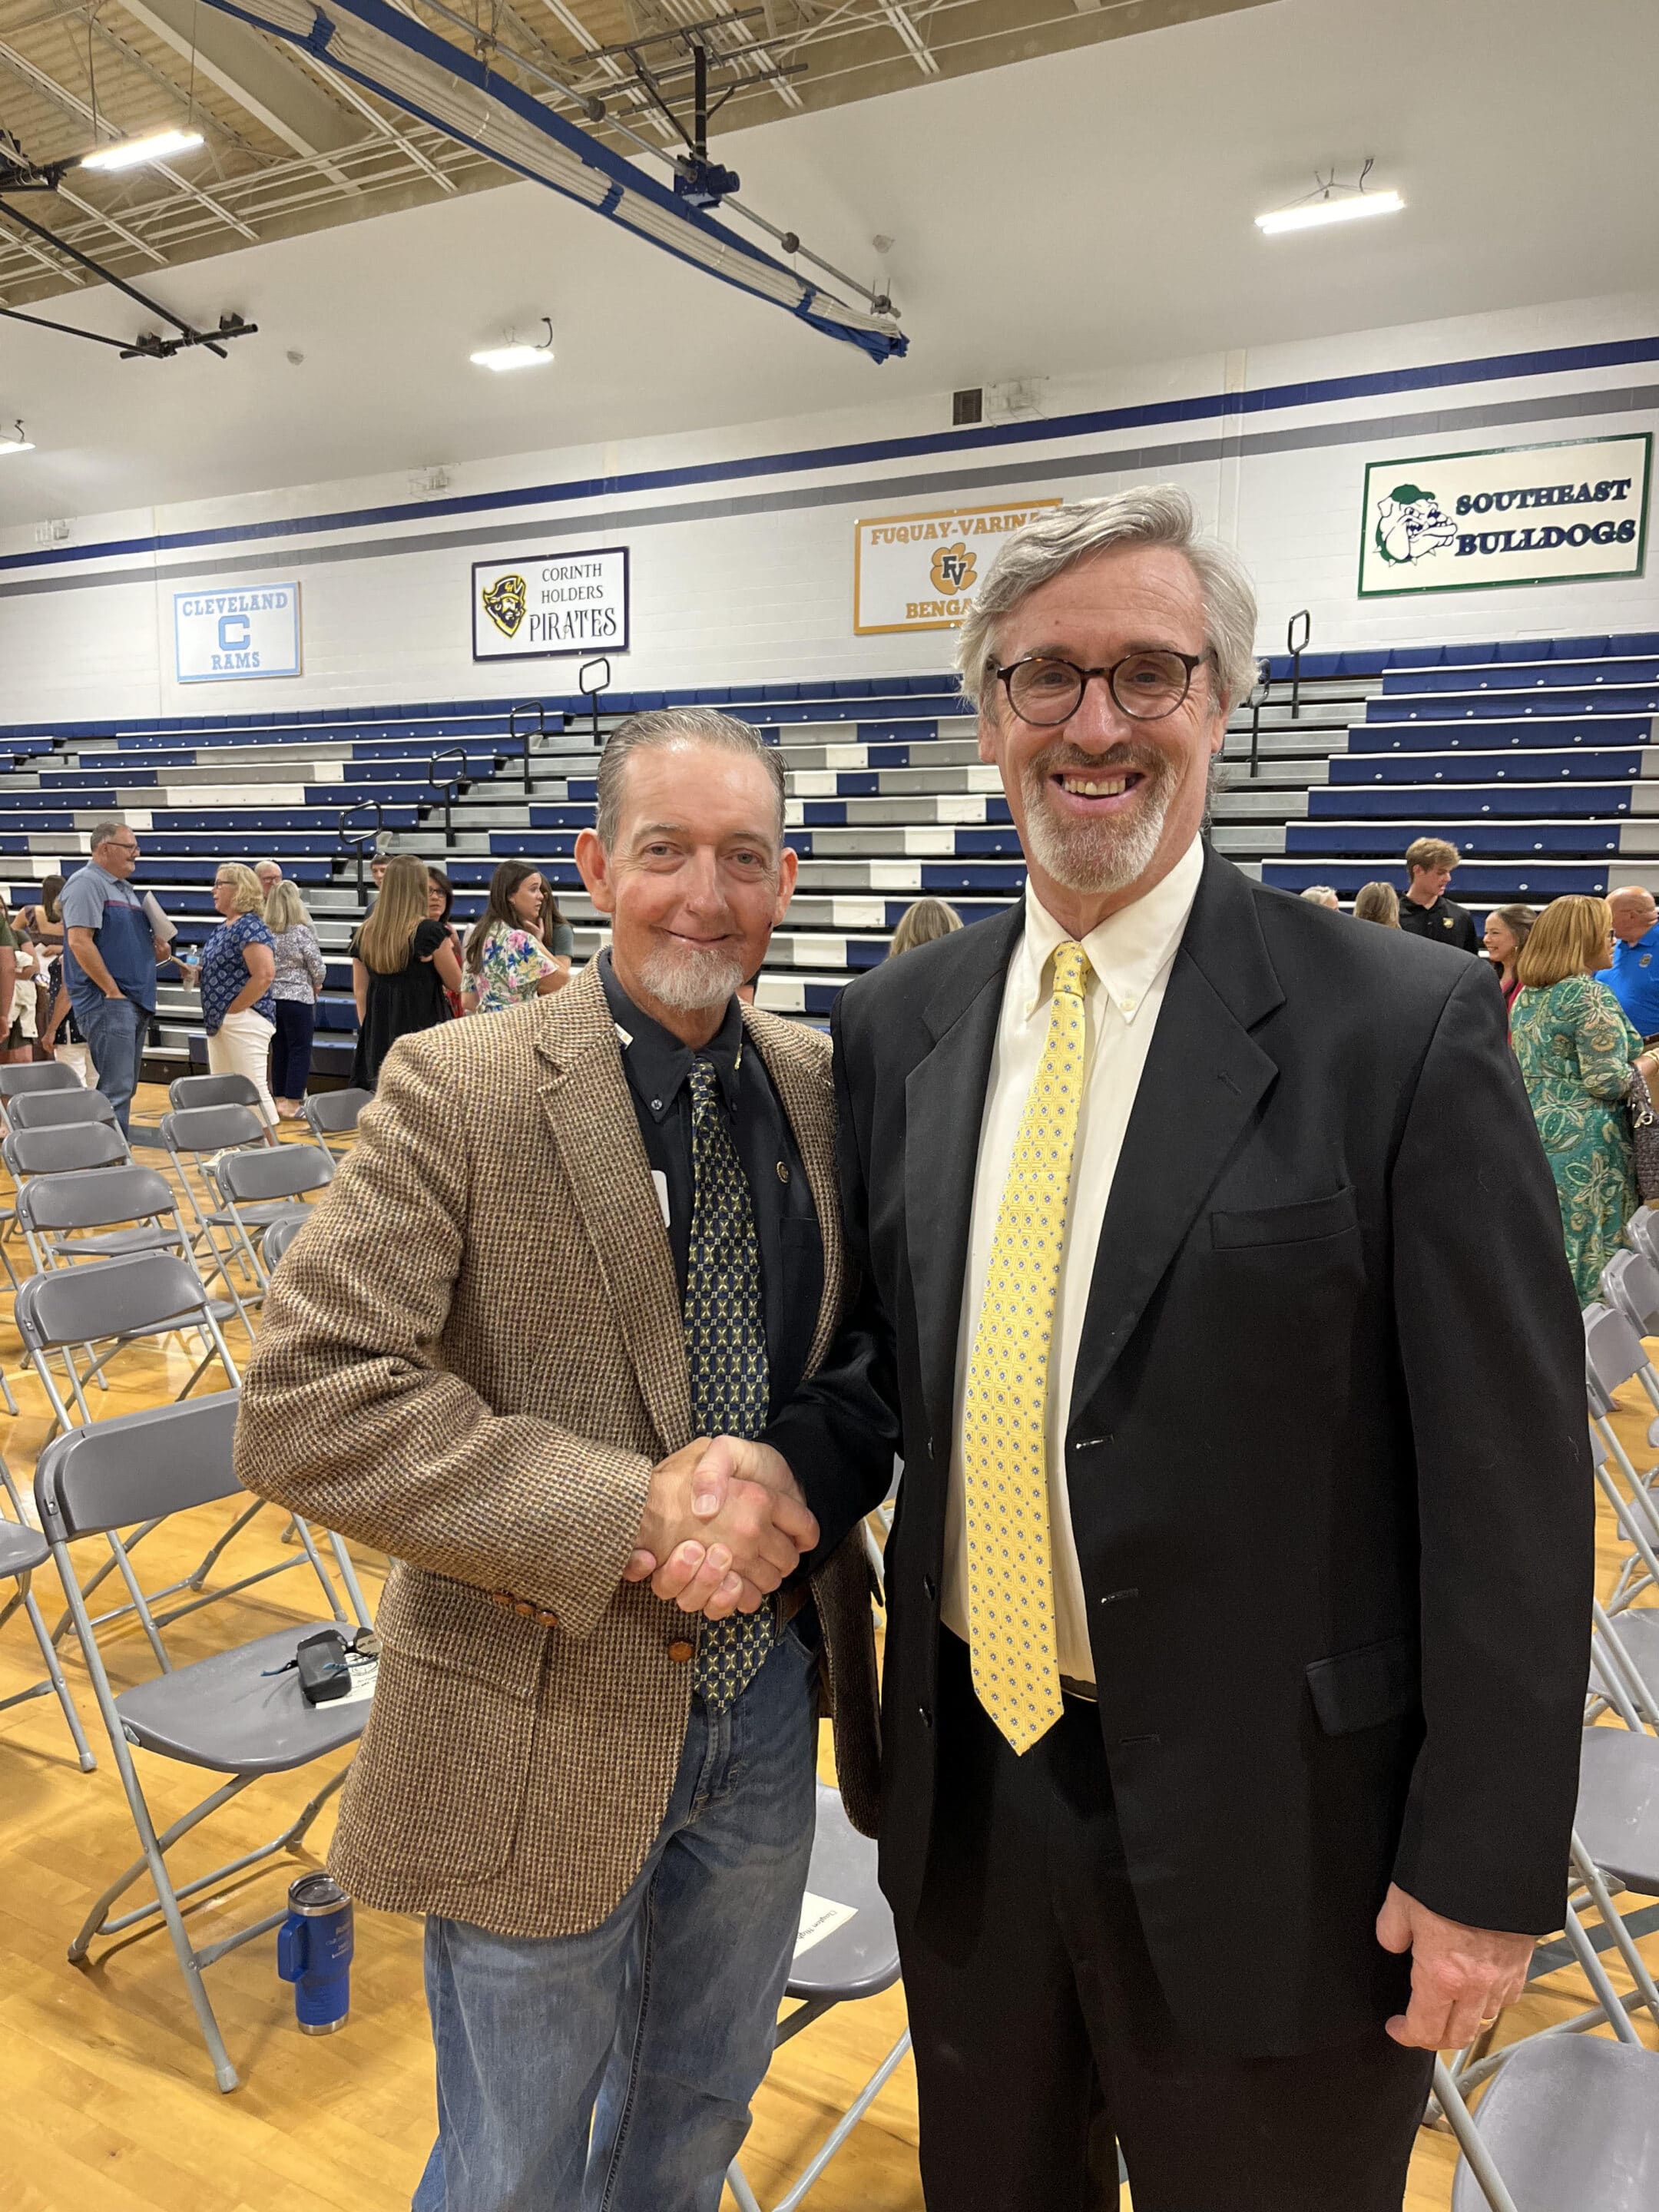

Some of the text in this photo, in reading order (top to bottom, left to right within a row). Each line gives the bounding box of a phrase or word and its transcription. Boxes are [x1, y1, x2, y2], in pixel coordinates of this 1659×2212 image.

[1455, 478, 1632, 516] SOUTHEAST
[871, 512, 1039, 545] FUQUAY-VARIN
[1455, 519, 1636, 556] BULLDOGS
[541, 563, 602, 582] CORINTH
[182, 592, 288, 617] CLEVELAND
[541, 584, 604, 604] HOLDERS
[218, 614, 251, 651] C
[529, 607, 618, 642] PIRATES
[211, 651, 260, 671] RAMS
